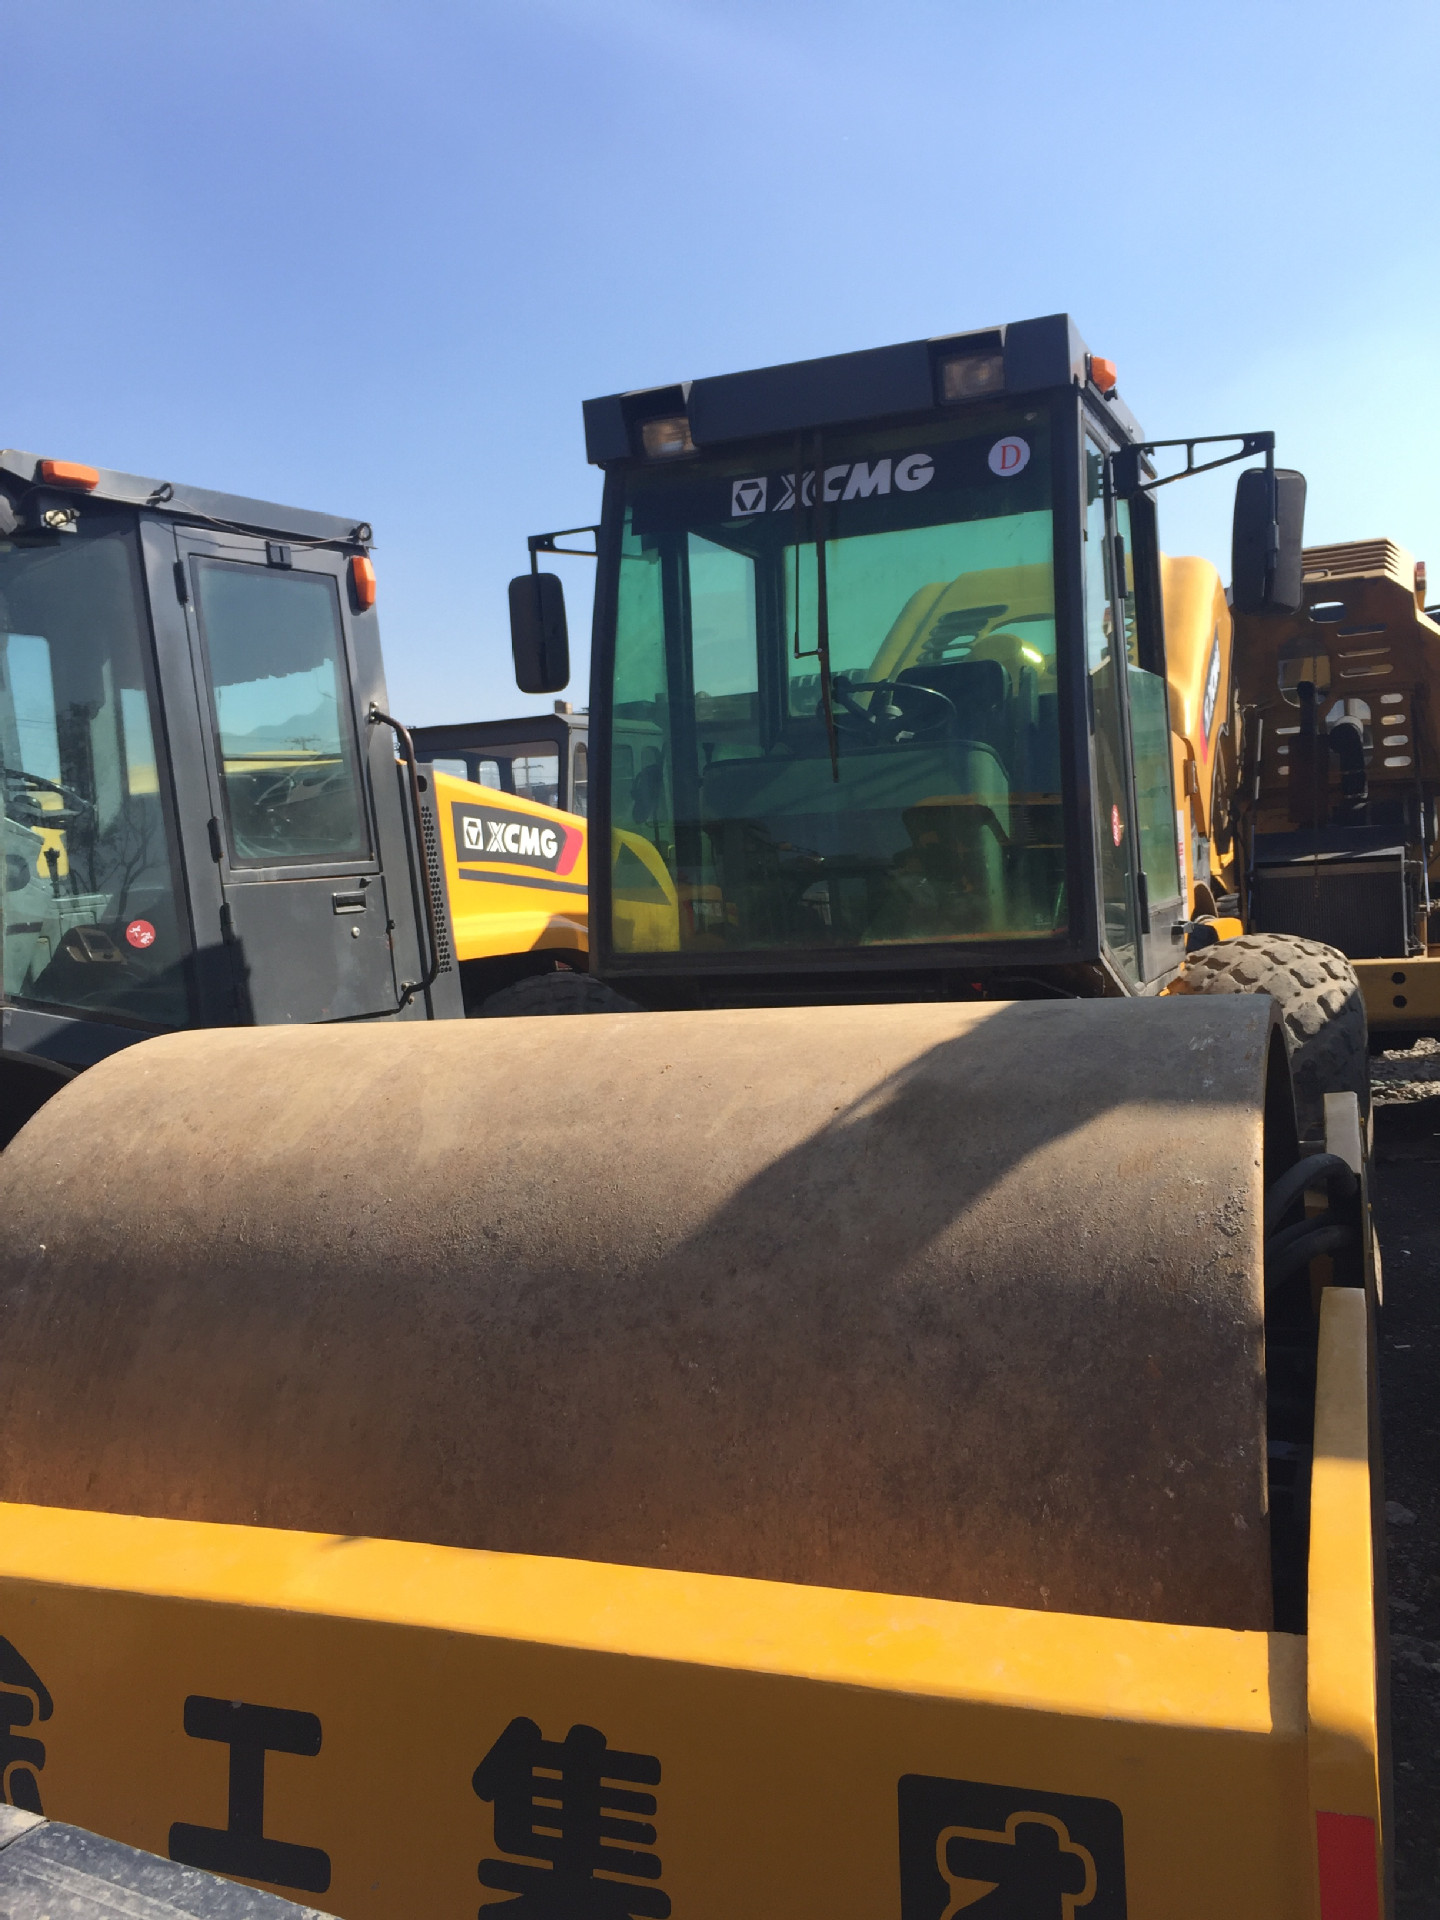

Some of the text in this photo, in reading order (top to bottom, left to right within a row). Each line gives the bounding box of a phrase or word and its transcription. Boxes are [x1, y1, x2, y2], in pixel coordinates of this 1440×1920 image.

[1000, 444, 1022, 470] D
[773, 453, 935, 512] XCMG
[486, 821, 558, 859] XCMG
